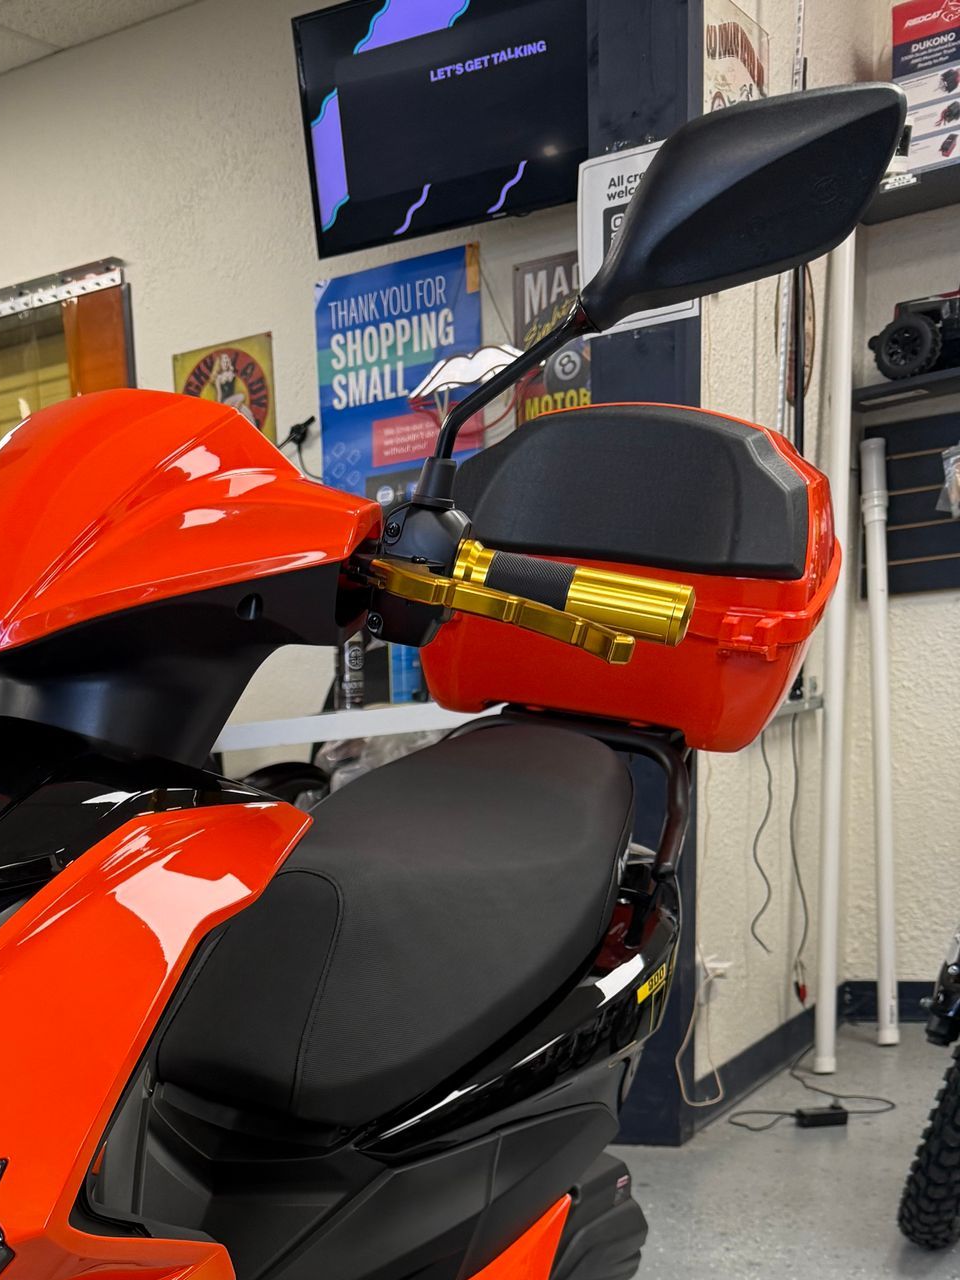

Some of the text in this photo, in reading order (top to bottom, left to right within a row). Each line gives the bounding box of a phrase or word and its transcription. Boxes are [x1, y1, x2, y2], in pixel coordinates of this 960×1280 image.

[430, 40, 547, 82] LET'S GET TALKING
[911, 32, 956, 53] DUKONO
[608, 174, 624, 189] All
[328, 275, 447, 330] THANK YOU FOR
[331, 308, 455, 370] SHOPPING
[332, 361, 410, 410] SMALL
[558, 354, 577, 376] 8
